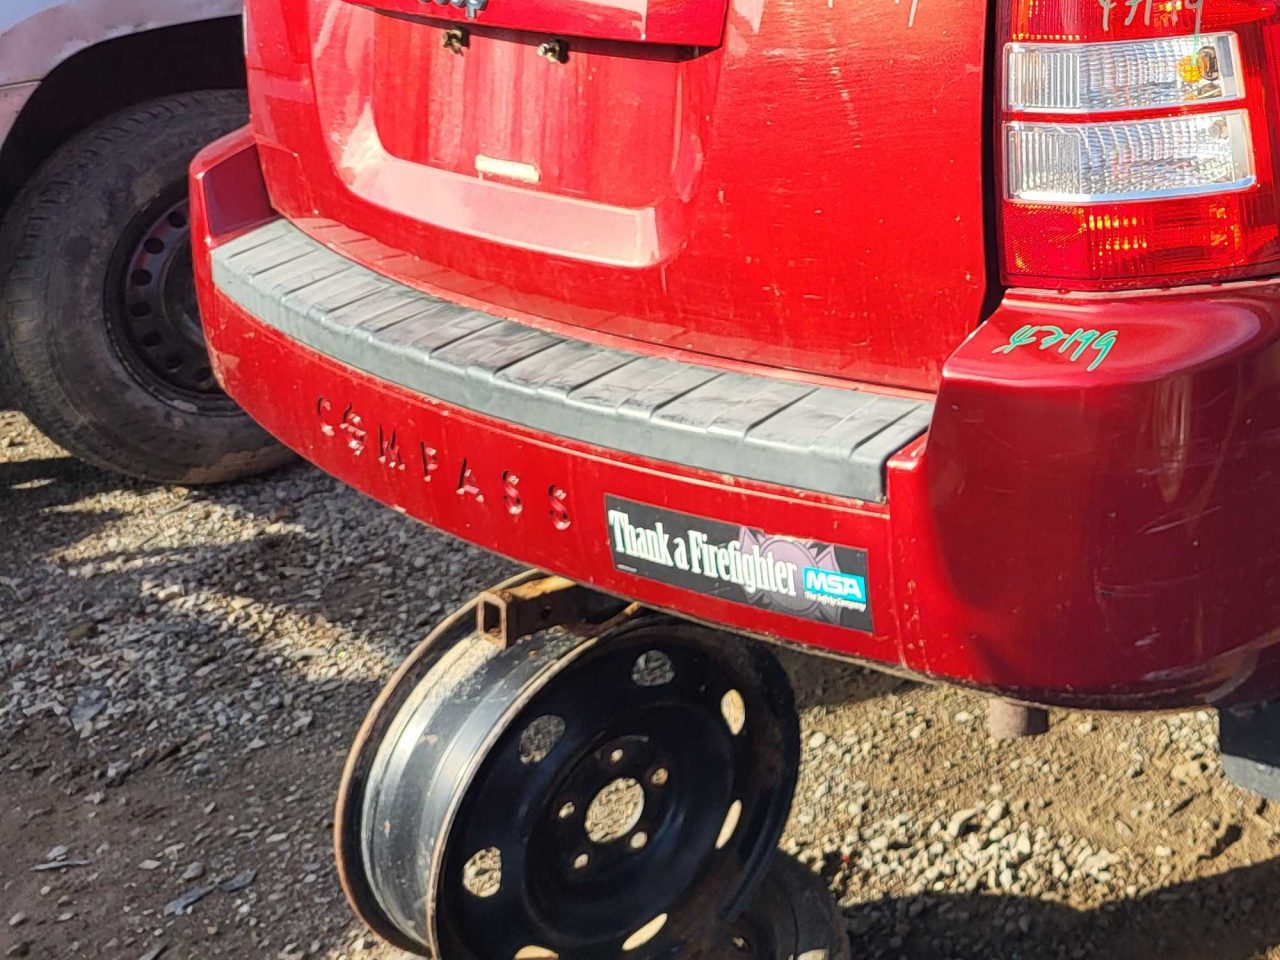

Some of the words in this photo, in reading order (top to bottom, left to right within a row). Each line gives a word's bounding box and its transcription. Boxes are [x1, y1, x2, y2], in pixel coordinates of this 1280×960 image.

[315, 395, 572, 530] COMPASS
[608, 509, 674, 568] Thank
[673, 537, 689, 572] a
[687, 529, 798, 598] Firefighter
[806, 570, 863, 600] MSA
